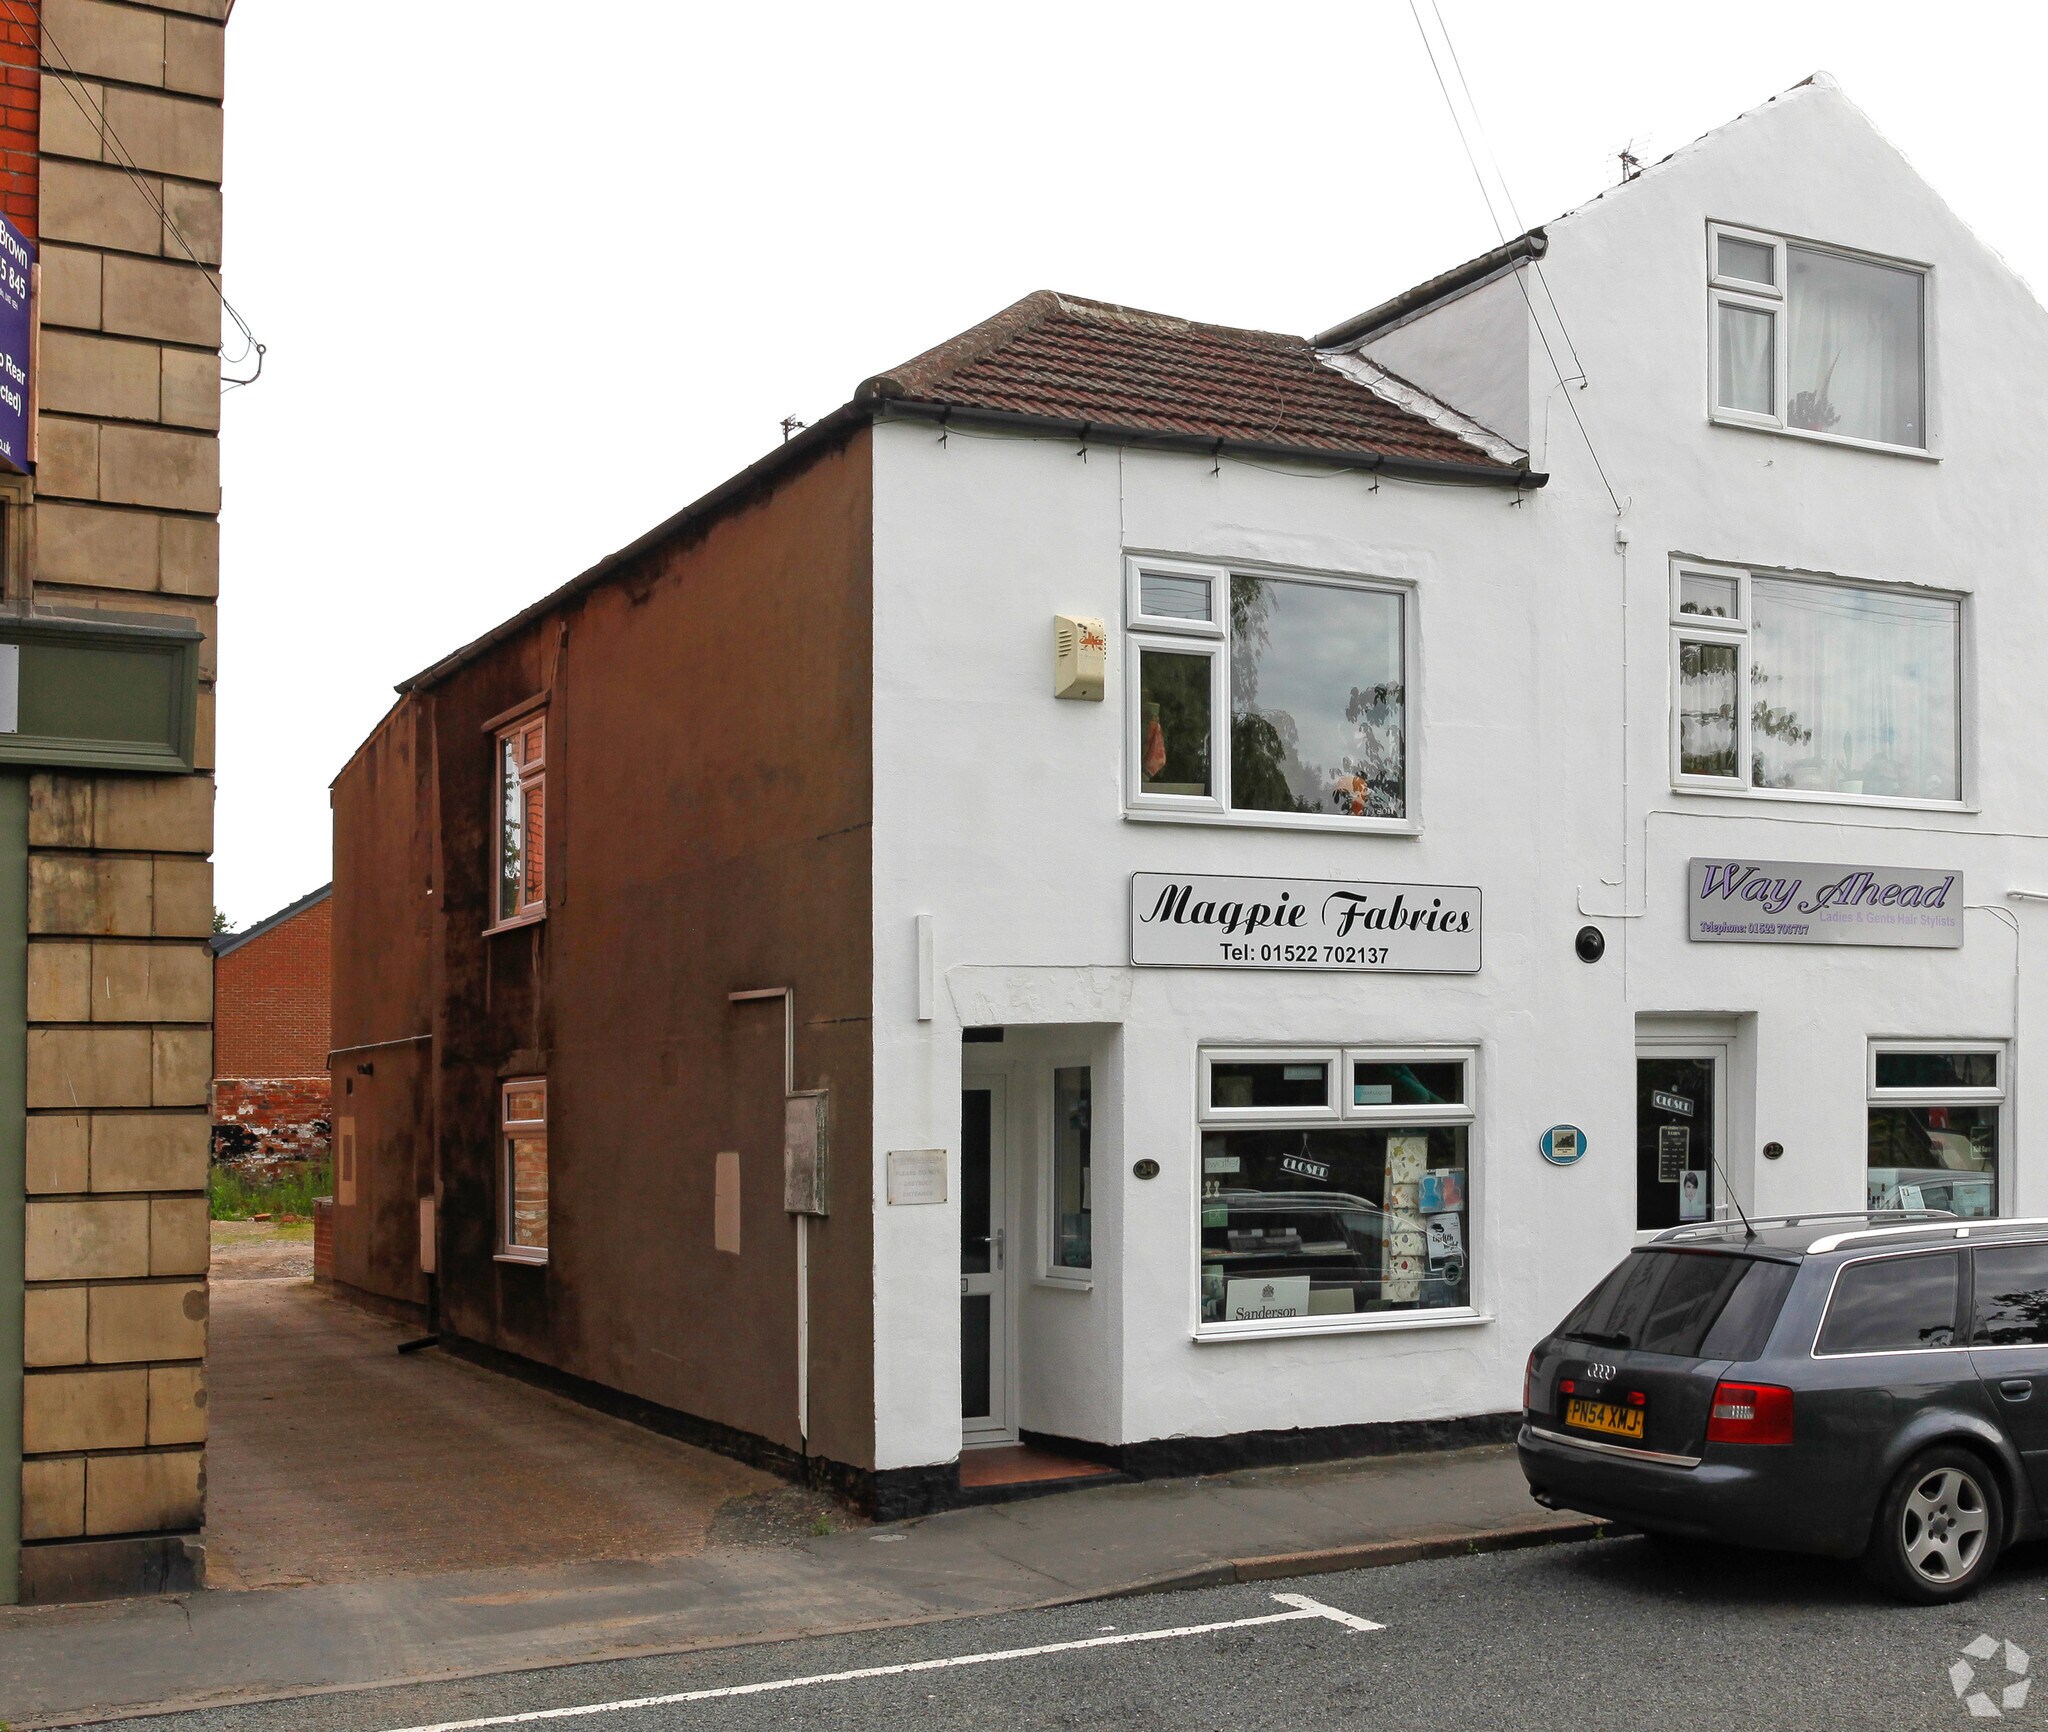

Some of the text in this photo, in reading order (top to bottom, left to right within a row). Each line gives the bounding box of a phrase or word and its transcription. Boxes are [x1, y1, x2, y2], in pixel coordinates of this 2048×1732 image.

[9, 266, 26, 300] 845
[5, 353, 26, 386] Rear
[0, 383, 21, 417] cted)
[1700, 862, 1955, 914] Way Ahead
[1139, 884, 1475, 938] Magpie Fabrics
[1819, 911, 1956, 928] Ladies & Gents Hair Stylists
[1700, 921, 1747, 936] Telephone:
[1748, 923, 1775, 935] 01522
[1220, 942, 1389, 965] Tel: 01522 702137
[1283, 1157, 1329, 1178] CLOSED
[1236, 1305, 1297, 1320] Sanderson
[1571, 1400, 1639, 1432] PN54 XMJ
